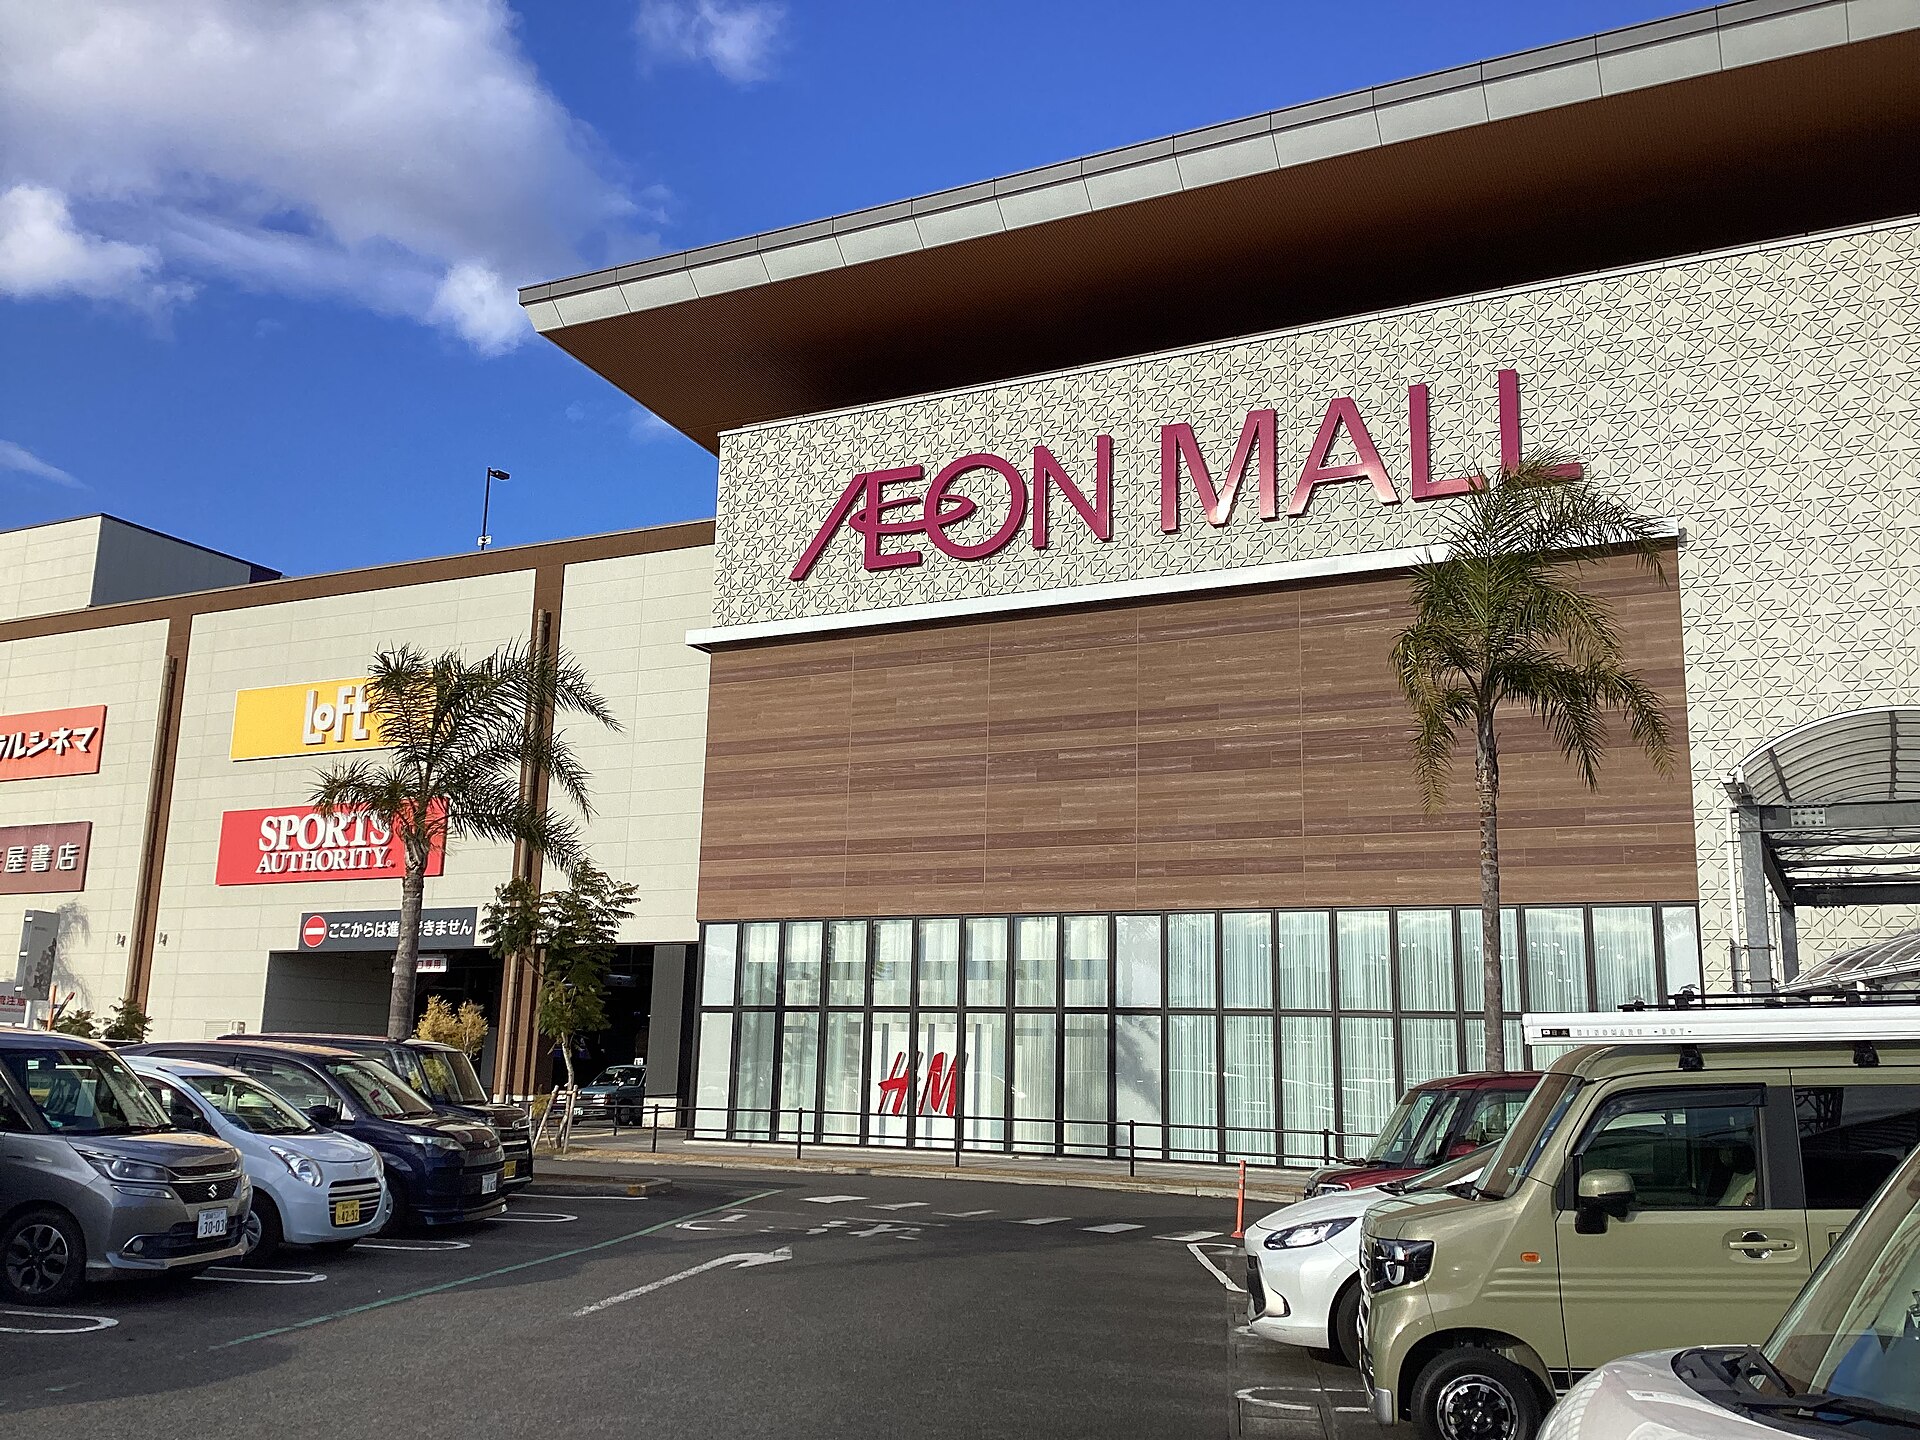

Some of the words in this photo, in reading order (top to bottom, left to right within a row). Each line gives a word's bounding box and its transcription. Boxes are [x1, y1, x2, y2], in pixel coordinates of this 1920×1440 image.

[1160, 368, 1584, 533] MALL
[258, 811, 393, 852] SPORTS
[0, 842, 80, 873] 屋書店
[328, 919, 473, 939] ここからは進きません
